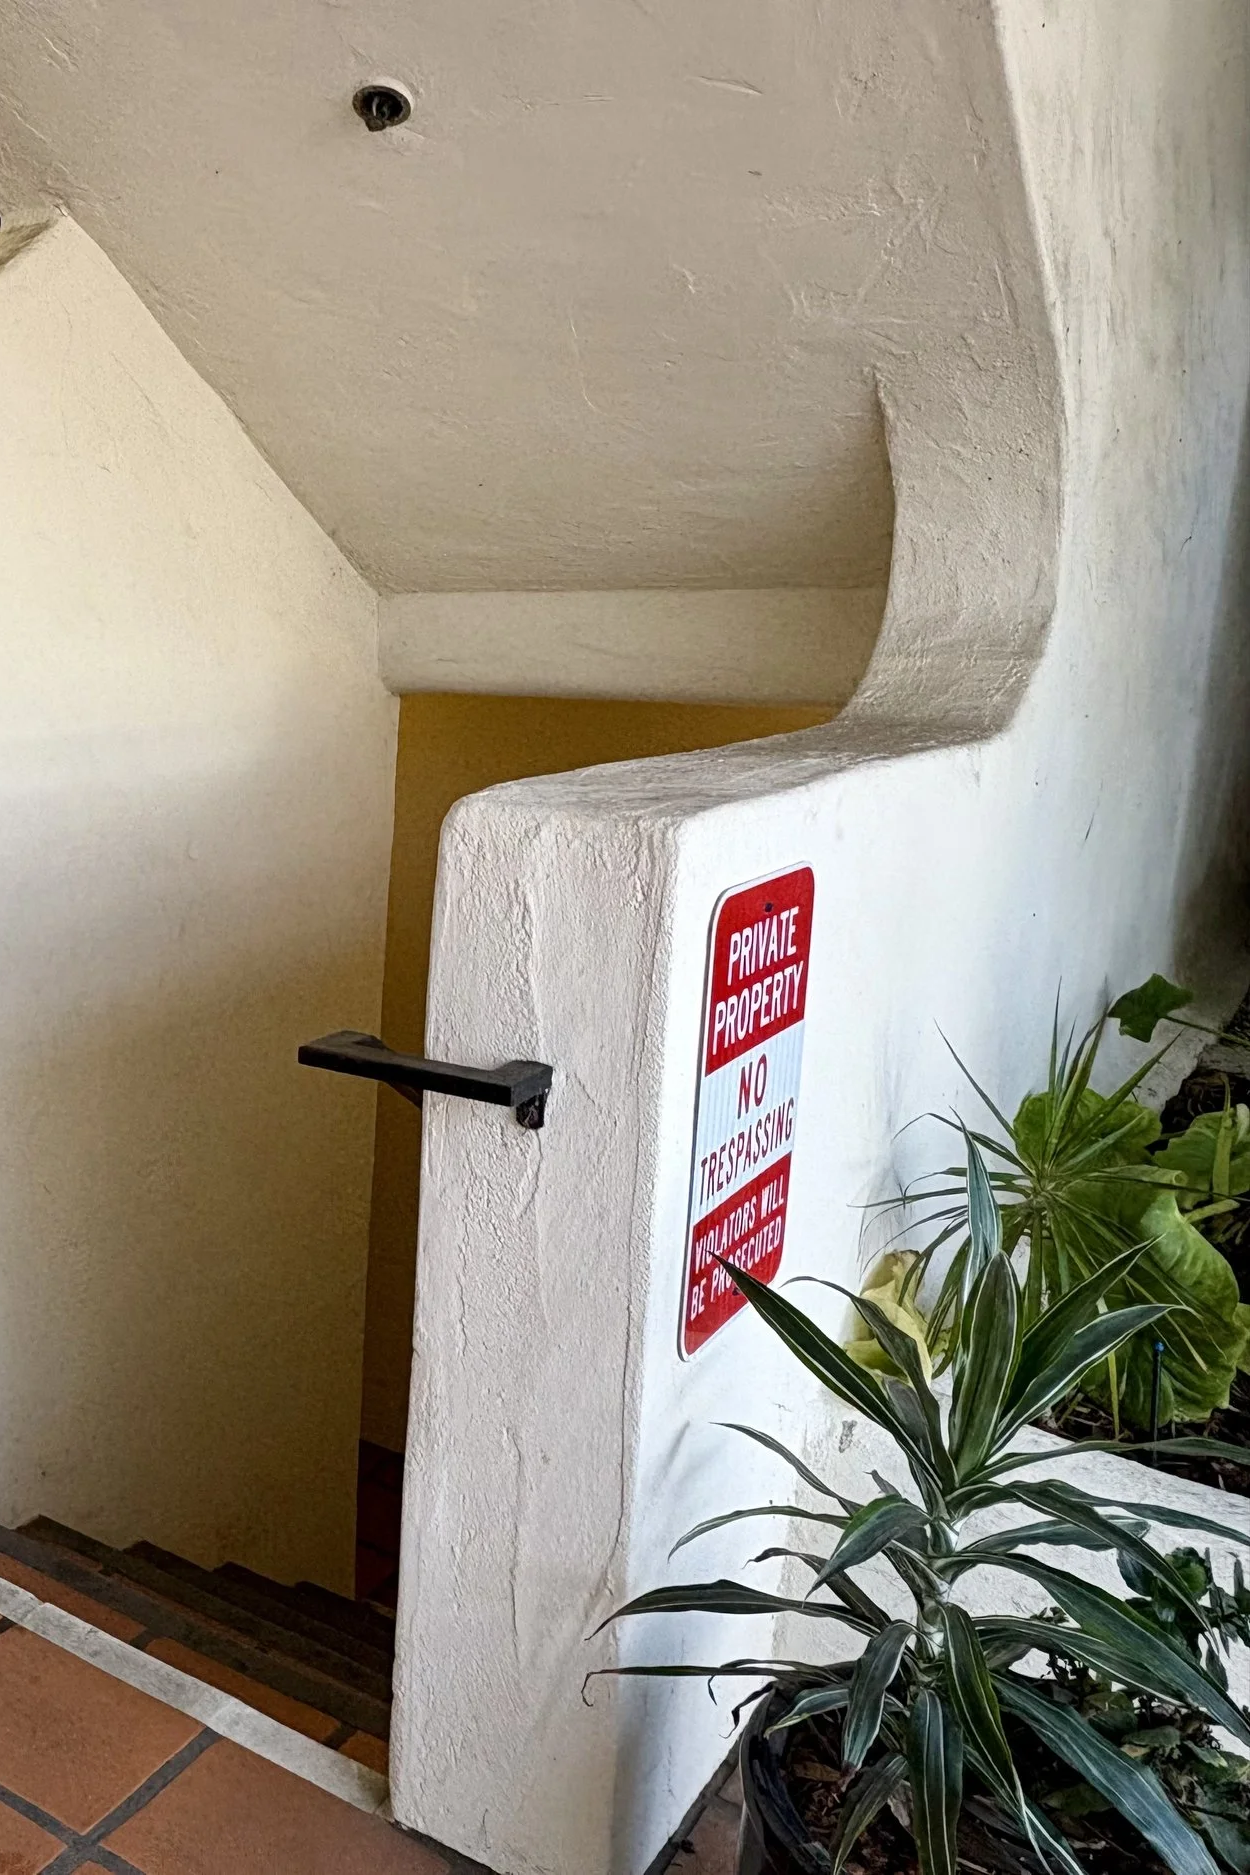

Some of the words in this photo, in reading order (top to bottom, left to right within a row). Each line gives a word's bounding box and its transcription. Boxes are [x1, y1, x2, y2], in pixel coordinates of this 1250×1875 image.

[727, 906, 799, 986] PRIVATE
[712, 960, 804, 1056] PROPERTY
[737, 1053, 768, 1119] NO
[700, 1097, 794, 1205] TRESPASSING
[695, 1195, 757, 1274] VIOLATORS
[760, 1174, 784, 1220] WILL
[690, 1277, 707, 1322] BE
